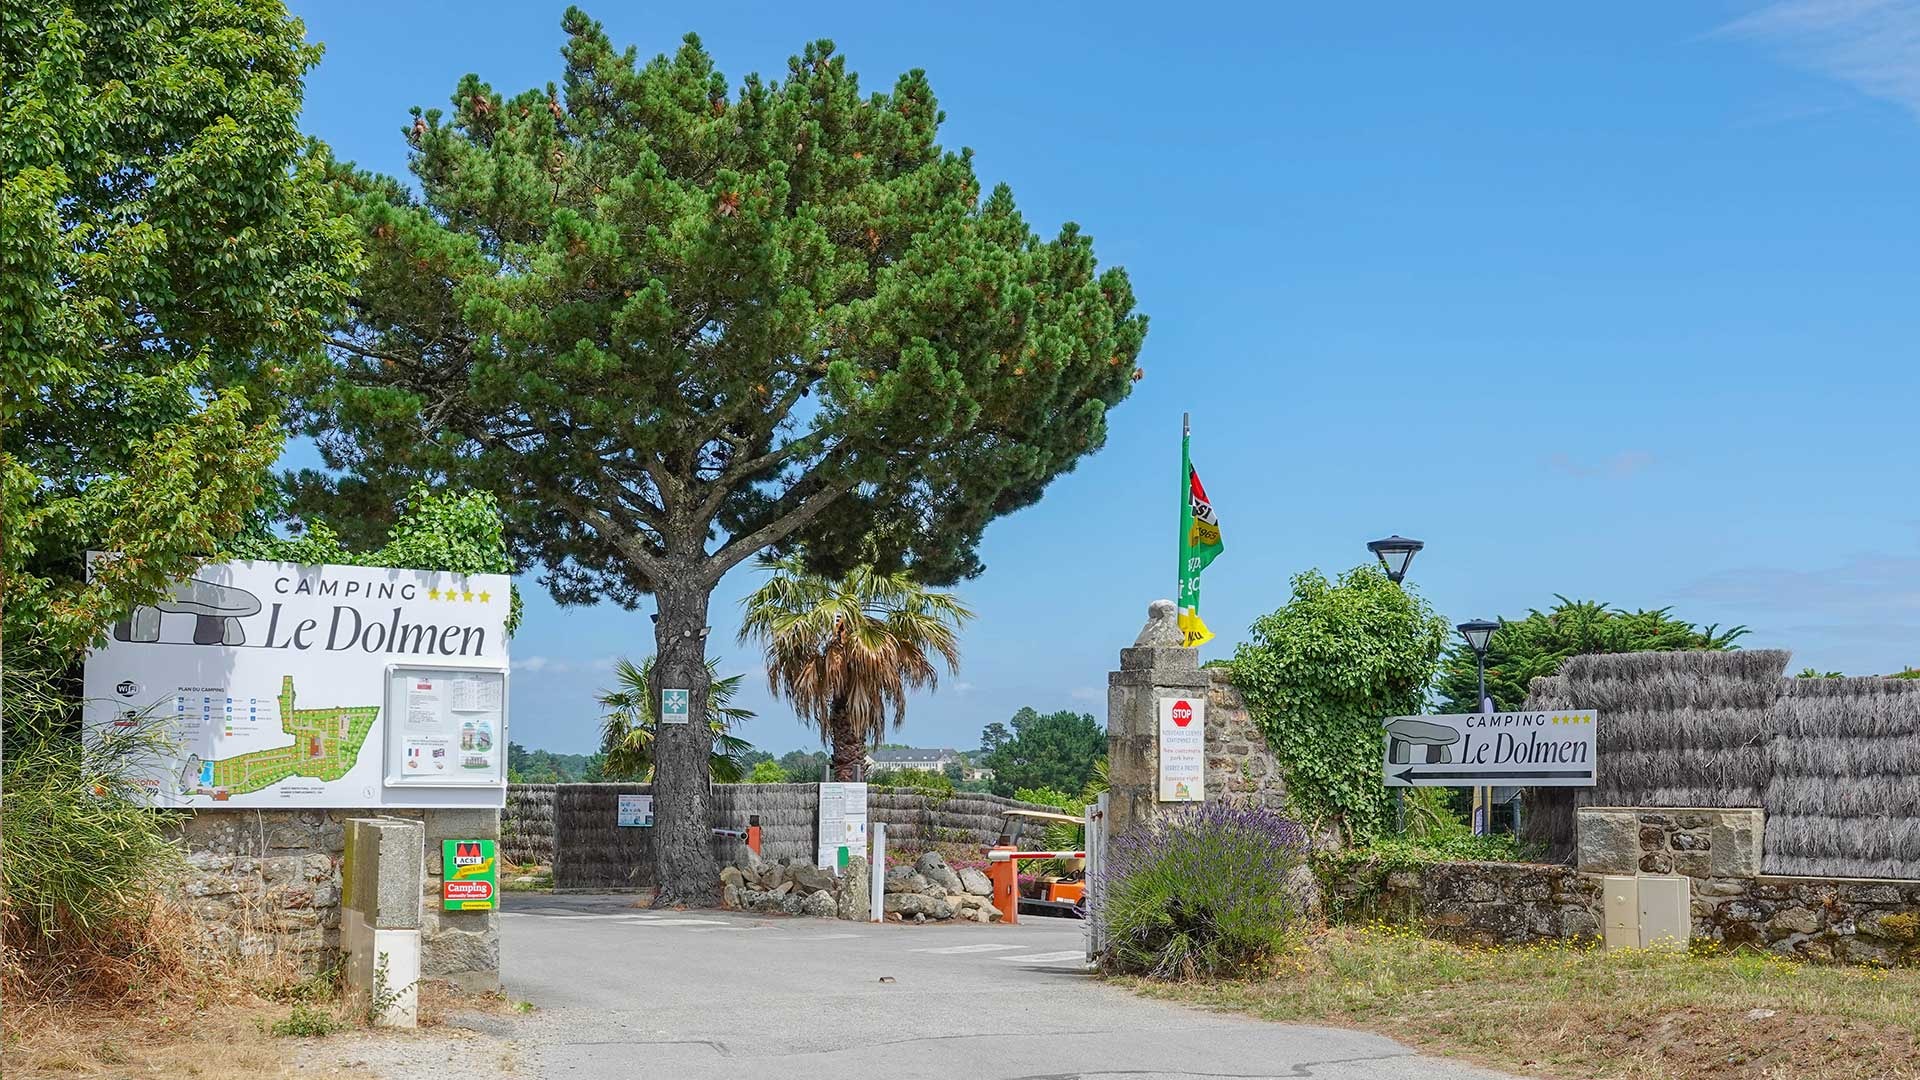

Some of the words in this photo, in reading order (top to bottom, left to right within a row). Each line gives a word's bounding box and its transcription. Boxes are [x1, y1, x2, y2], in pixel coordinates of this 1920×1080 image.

[274, 577, 416, 600] CAMPING
[265, 603, 317, 650] Le
[325, 605, 485, 656] Dolmen
[1173, 708, 1192, 719] STOP
[1466, 714, 1545, 728] CAMPING
[1461, 734, 1489, 764] Le
[1494, 731, 1588, 764] Dolmen
[447, 882, 487, 894] Camping
